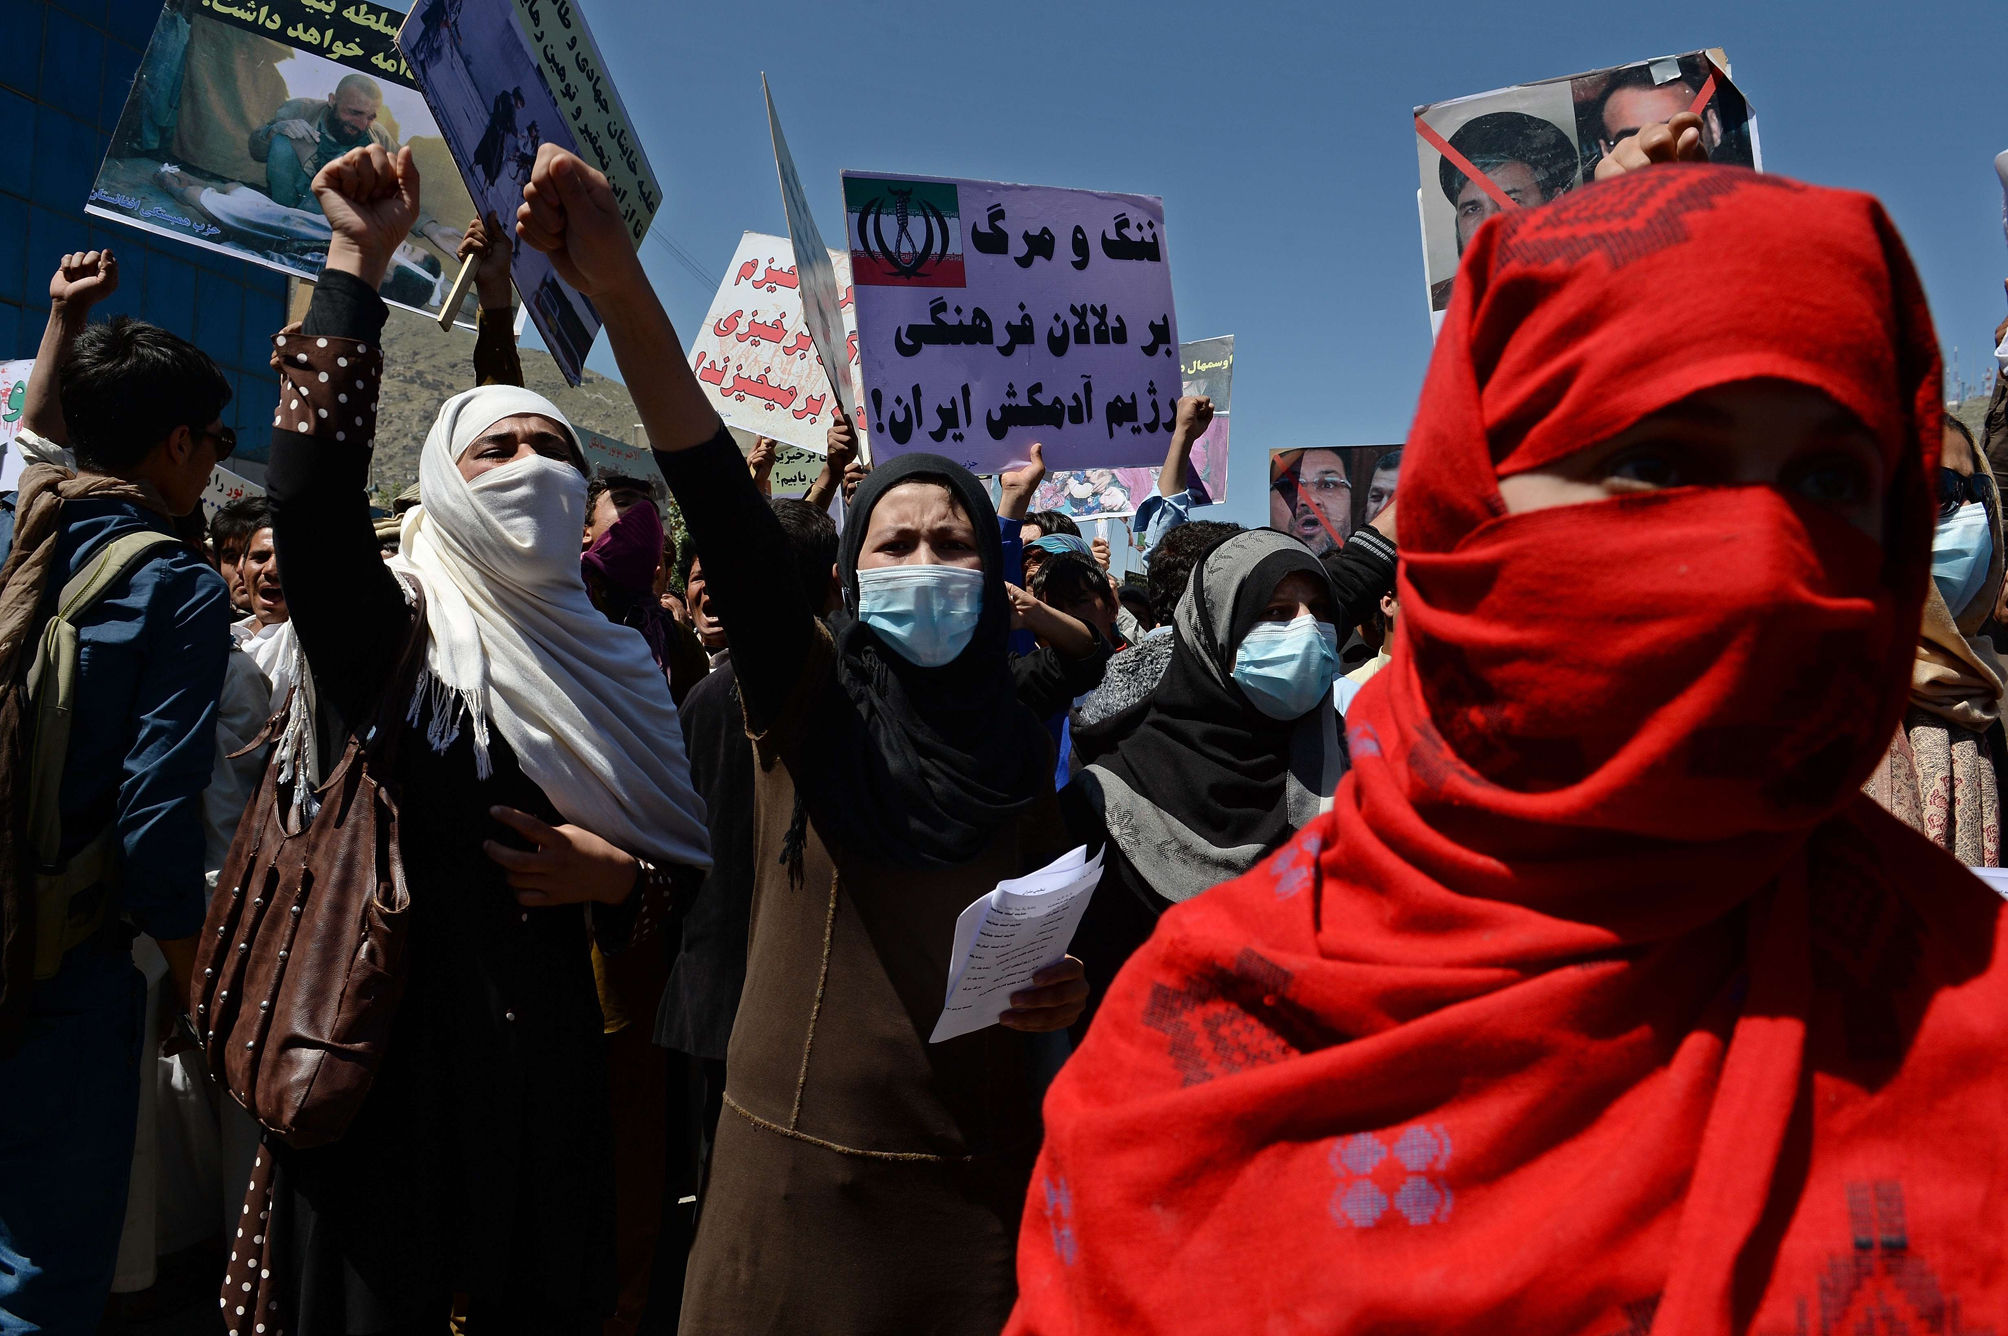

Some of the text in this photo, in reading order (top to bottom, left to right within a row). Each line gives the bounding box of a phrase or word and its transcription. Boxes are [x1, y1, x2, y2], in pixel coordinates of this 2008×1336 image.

[286, 22, 365, 59] خواهد
[566, 36, 577, 51] و
[543, 44, 579, 102] توهین
[575, 52, 609, 114] جهادی
[571, 106, 582, 121] و
[578, 124, 611, 171] تحقیر
[637, 180, 654, 214] علیه
[193, 223, 220, 236] حزب
[633, 219, 643, 239] تا
[971, 203, 1161, 270] ننگ و مرگ
[895, 296, 1035, 357] فرهنگی
[1047, 303, 1128, 357] دلالان
[1141, 314, 1173, 358] بر
[871, 383, 972, 445] ایران!
[986, 374, 1092, 440] آدمکش
[1106, 380, 1177, 440] رژیم
